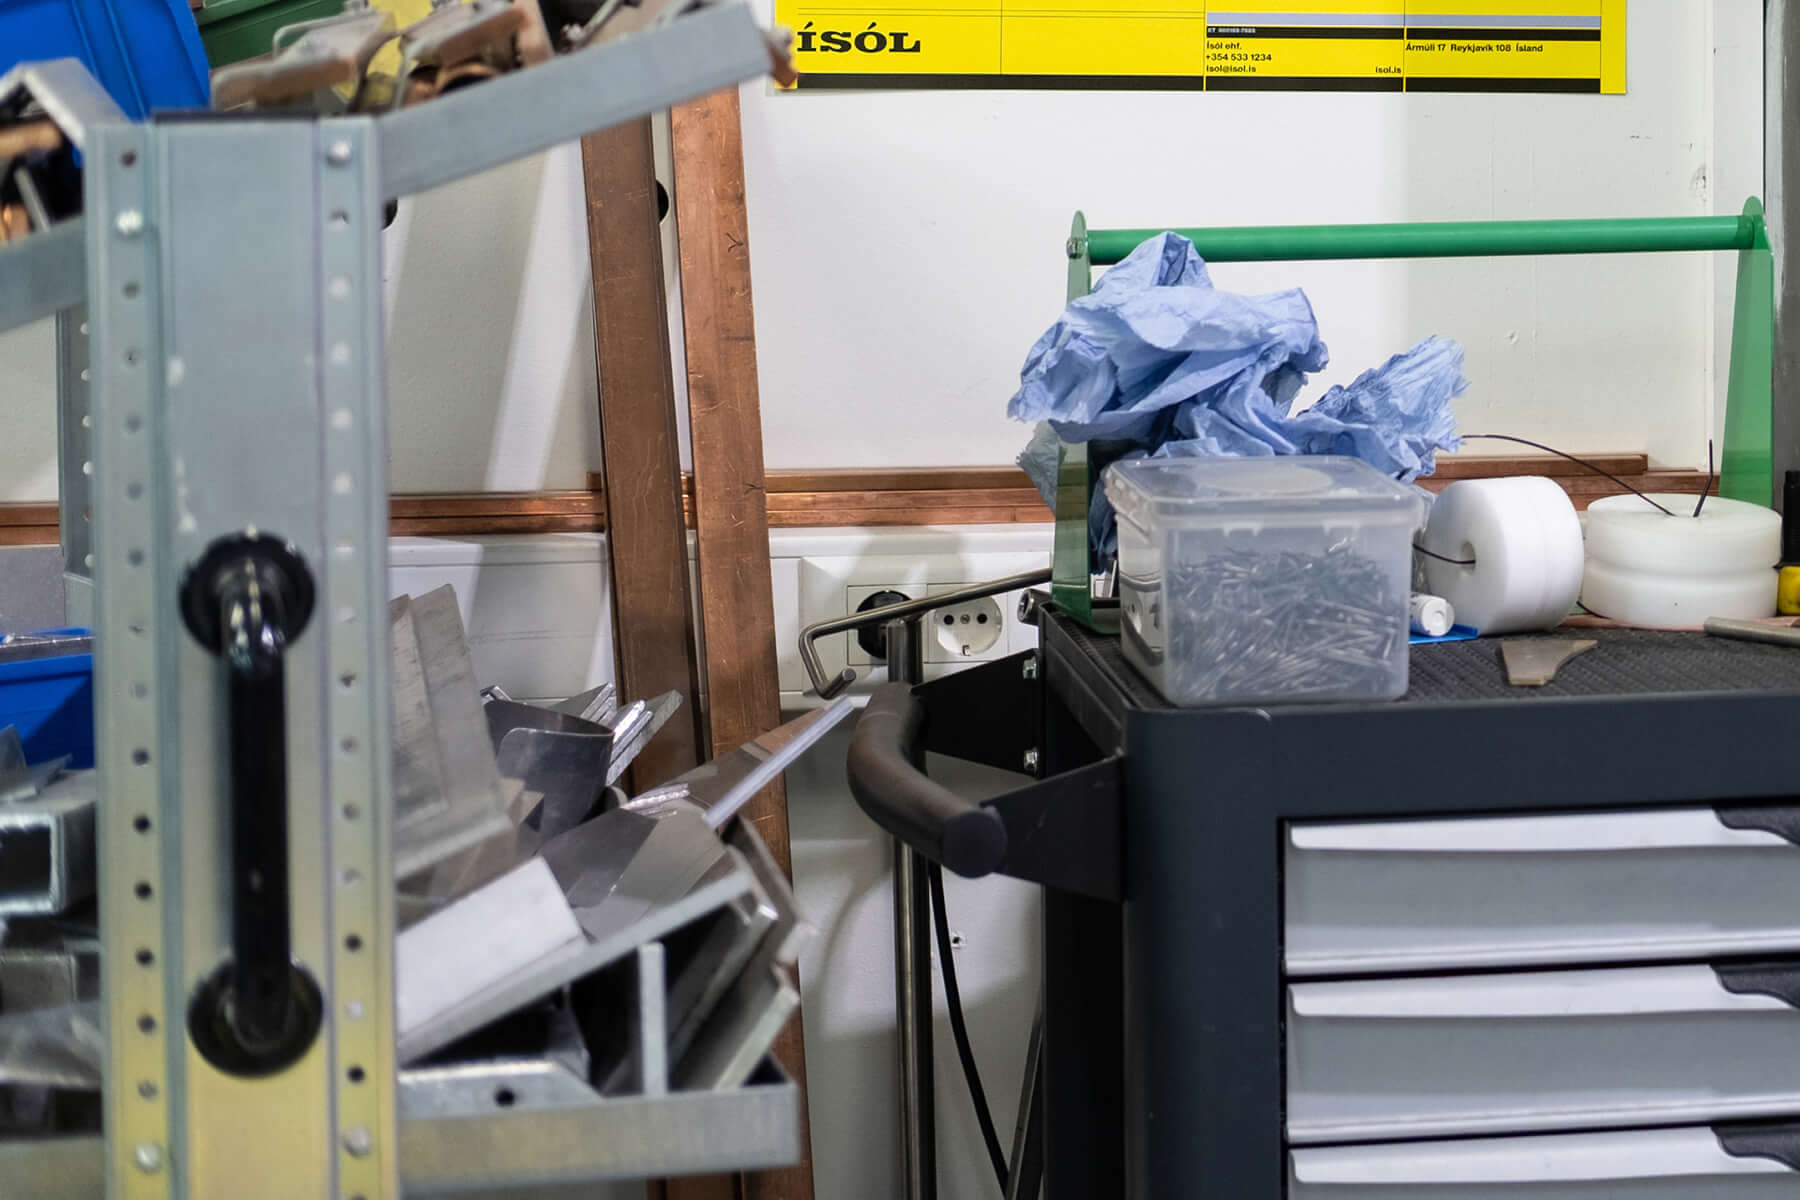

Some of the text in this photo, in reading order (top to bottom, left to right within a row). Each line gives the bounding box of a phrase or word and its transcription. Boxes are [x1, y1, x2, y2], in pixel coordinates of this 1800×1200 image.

[1437, 43, 1446, 52] 17
[1495, 44, 1511, 52] 108
[1205, 53, 1272, 62] +354 533 1234
[1375, 66, 1402, 74] isol.is
